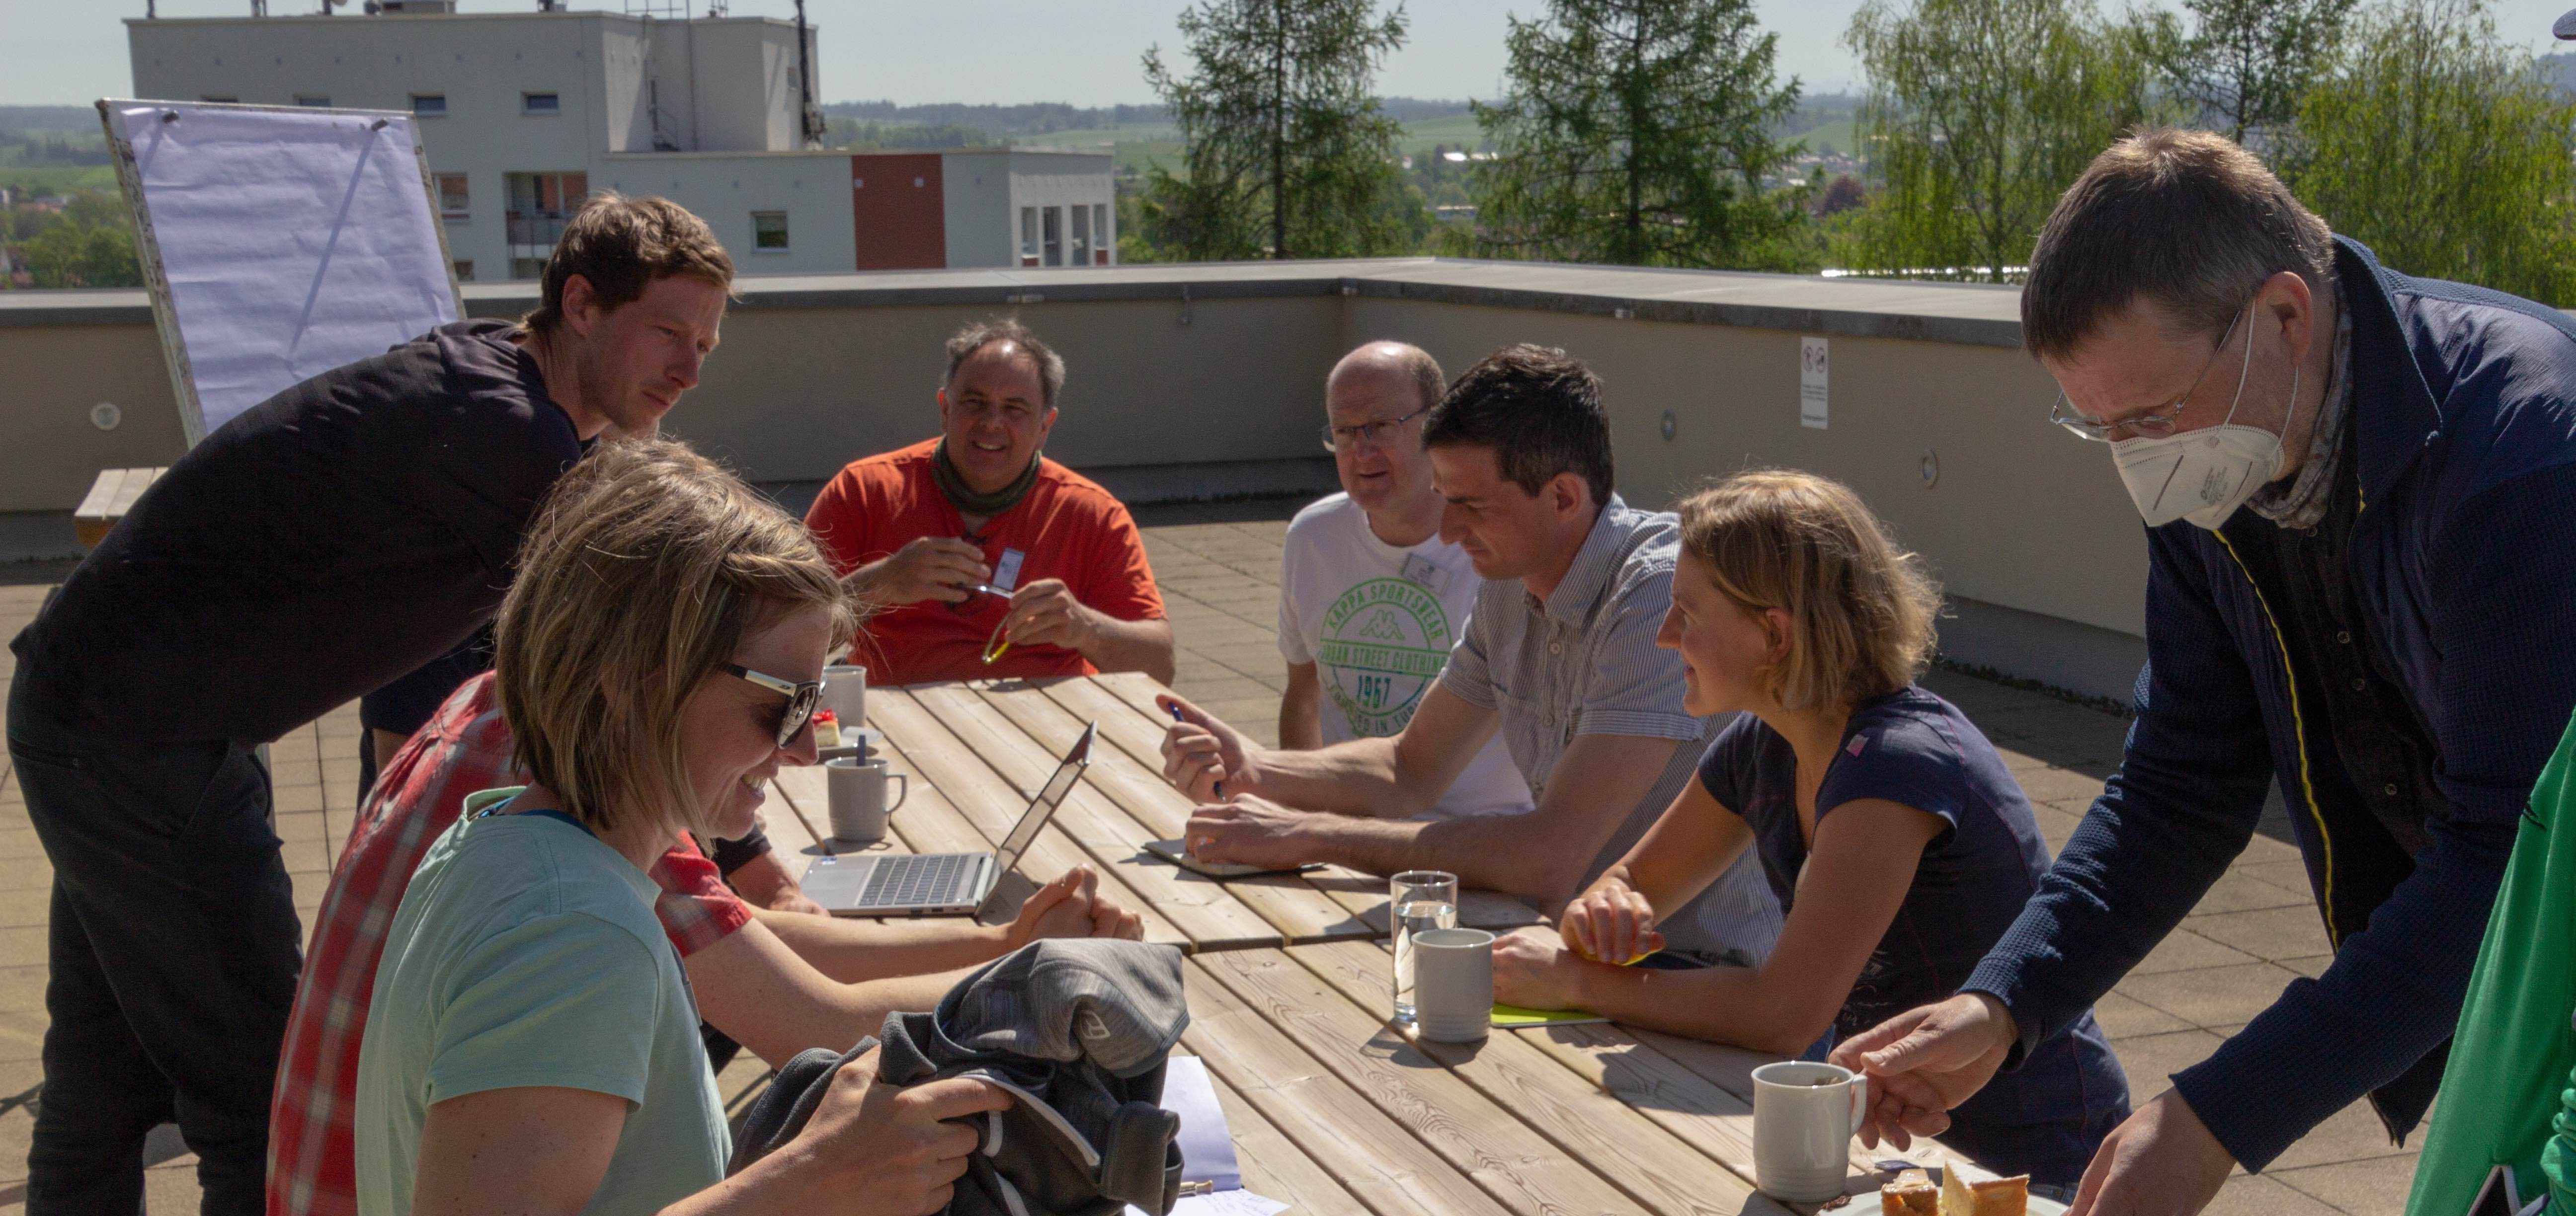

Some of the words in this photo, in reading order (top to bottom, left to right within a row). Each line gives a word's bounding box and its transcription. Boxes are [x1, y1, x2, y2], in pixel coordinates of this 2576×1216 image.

[1328, 589, 1365, 629] KAPPA
[1370, 585, 1445, 639] SPORTSWEAR
[1353, 648, 1391, 668] STREET
[1357, 675, 1391, 709] 1967
